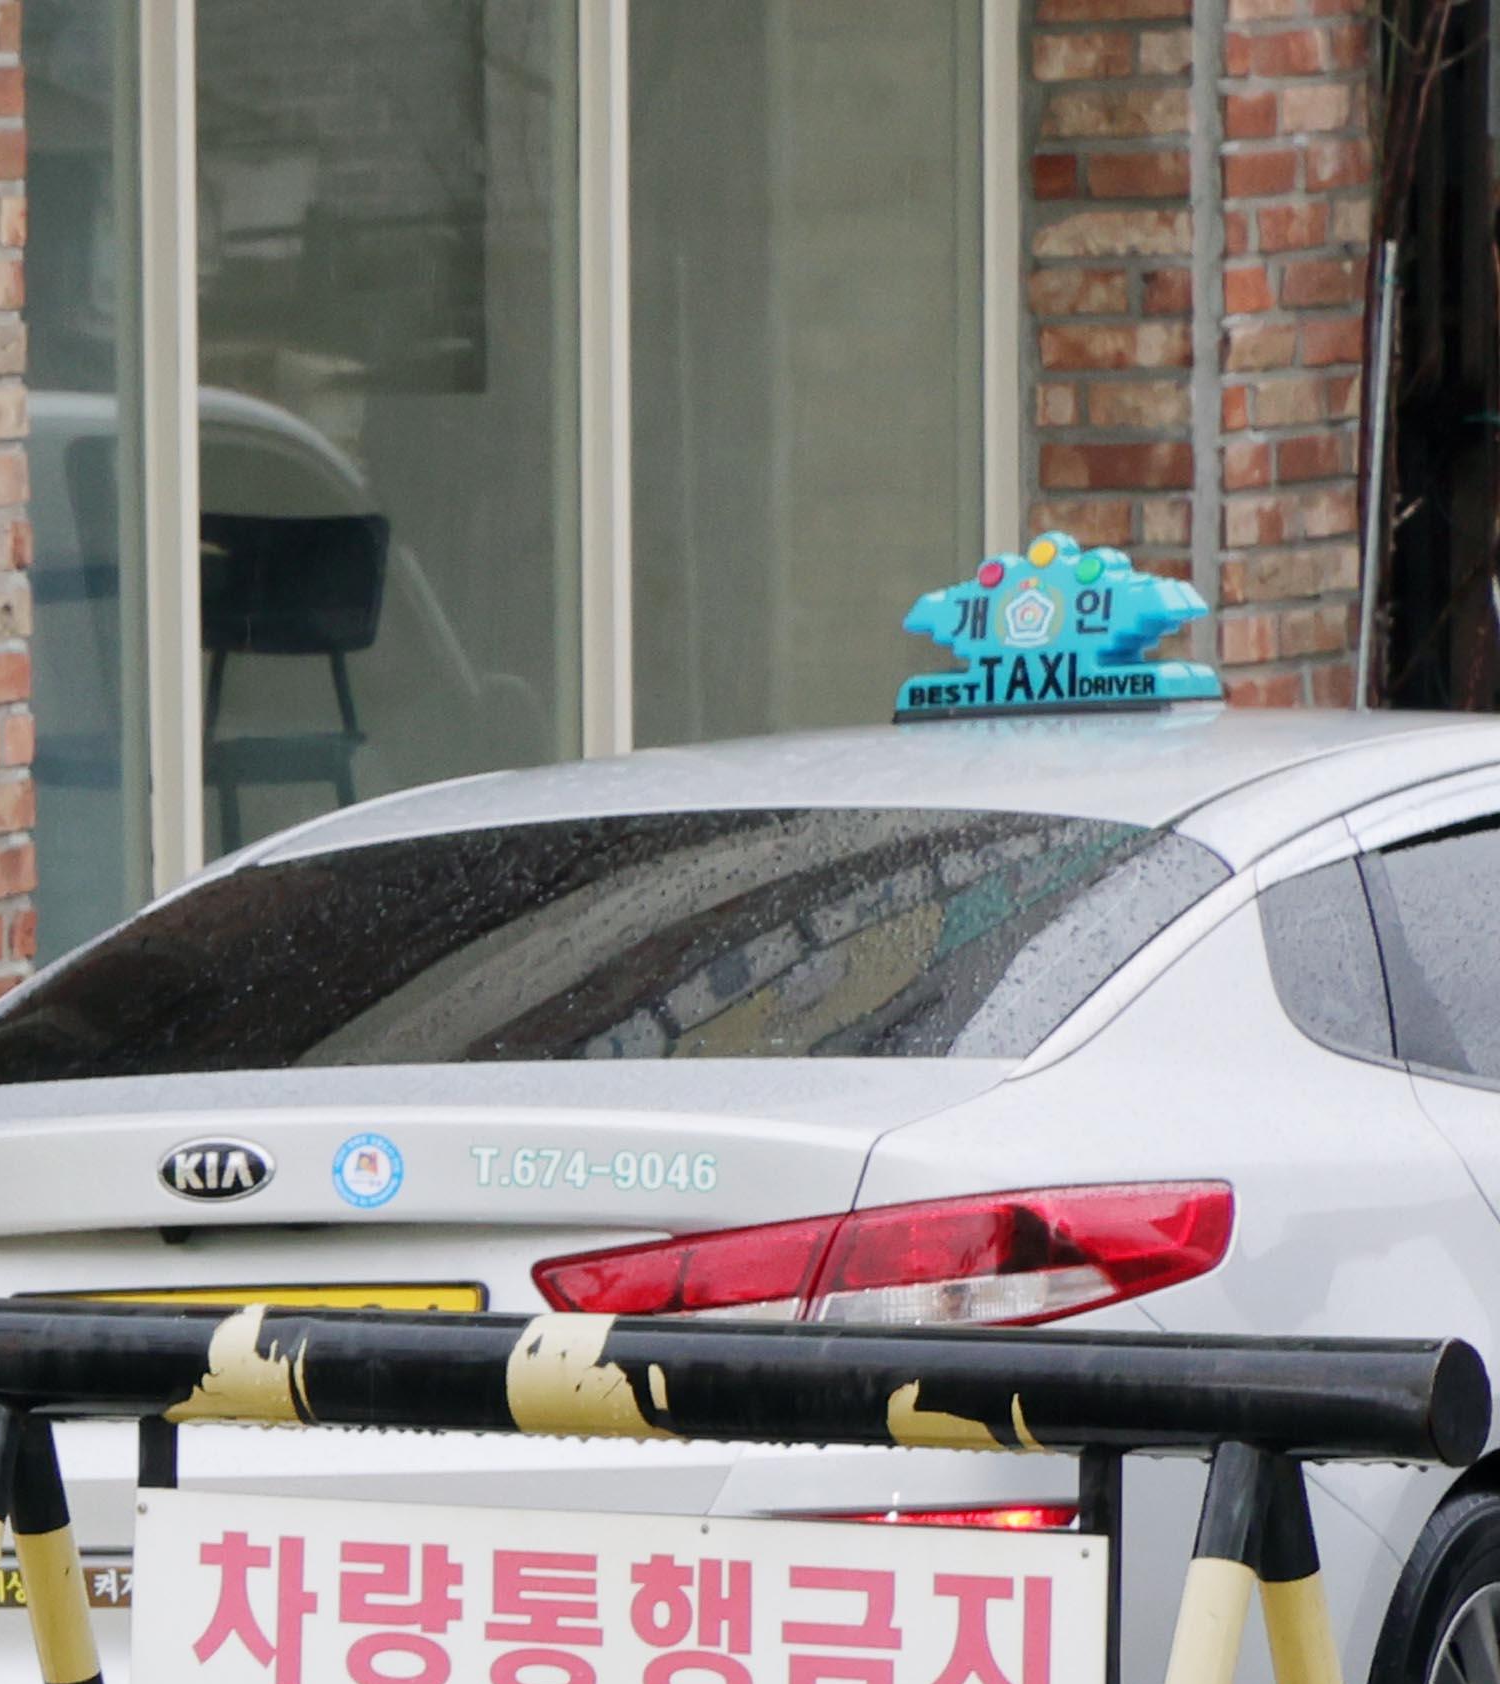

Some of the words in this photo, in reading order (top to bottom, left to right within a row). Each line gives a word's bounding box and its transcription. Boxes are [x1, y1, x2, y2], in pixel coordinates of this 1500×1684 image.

[908, 683, 980, 707] BEST
[979, 652, 1078, 703] TAXI
[1078, 673, 1156, 697] DRIVER
[174, 1150, 255, 1190] KIA
[470, 1146, 718, 1192] T.674-9046
